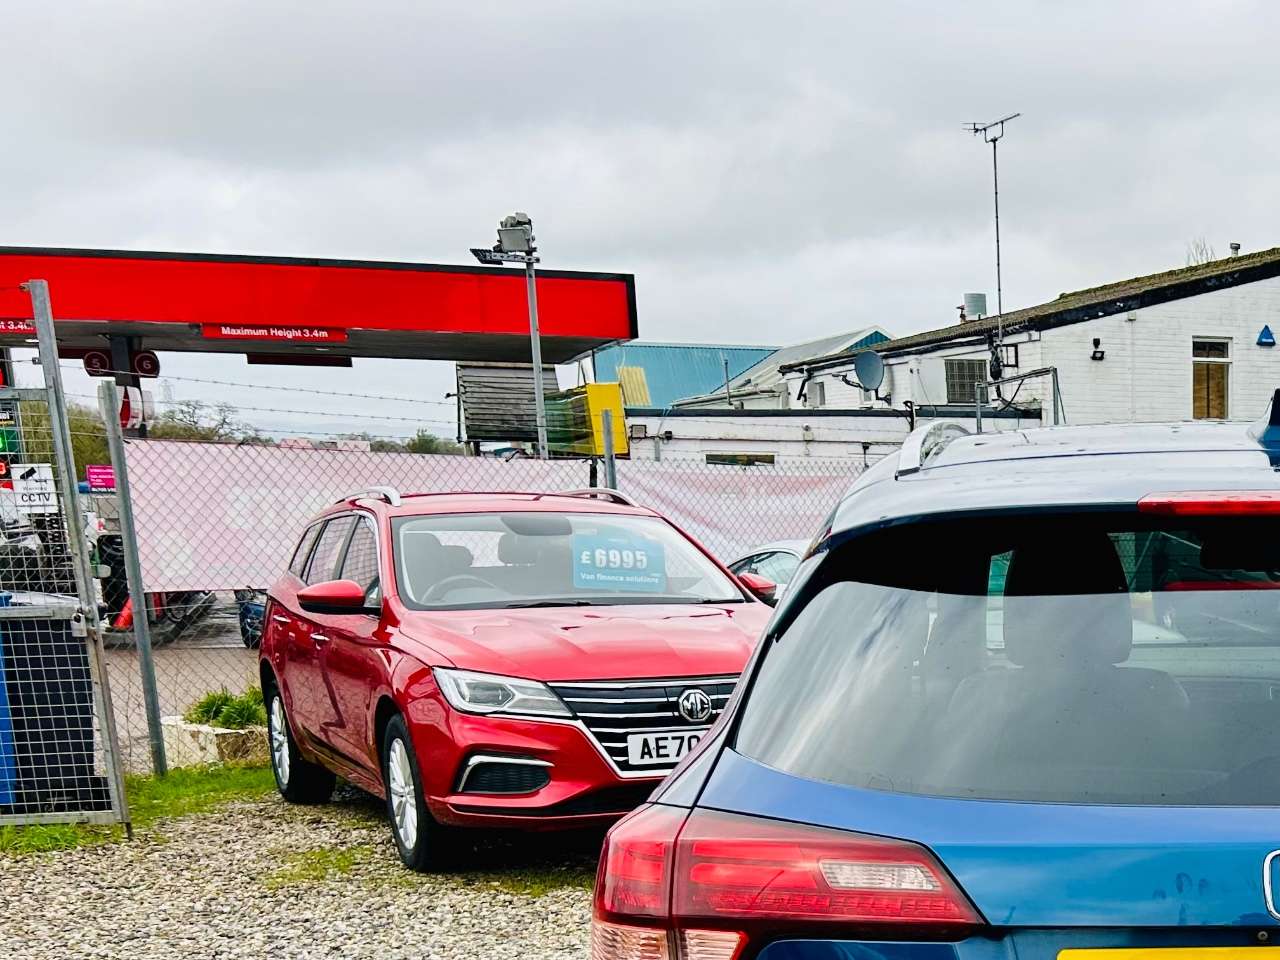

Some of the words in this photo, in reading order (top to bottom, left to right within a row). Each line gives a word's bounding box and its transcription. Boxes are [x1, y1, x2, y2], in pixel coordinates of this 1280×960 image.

[221, 326, 268, 336] Maximum
[270, 328, 302, 338] Height
[303, 329, 328, 338] 3.4m
[92, 358, 100, 368] 5
[142, 361, 151, 370] 6
[21, 492, 51, 503] CCTV
[681, 691, 709, 720] MG
